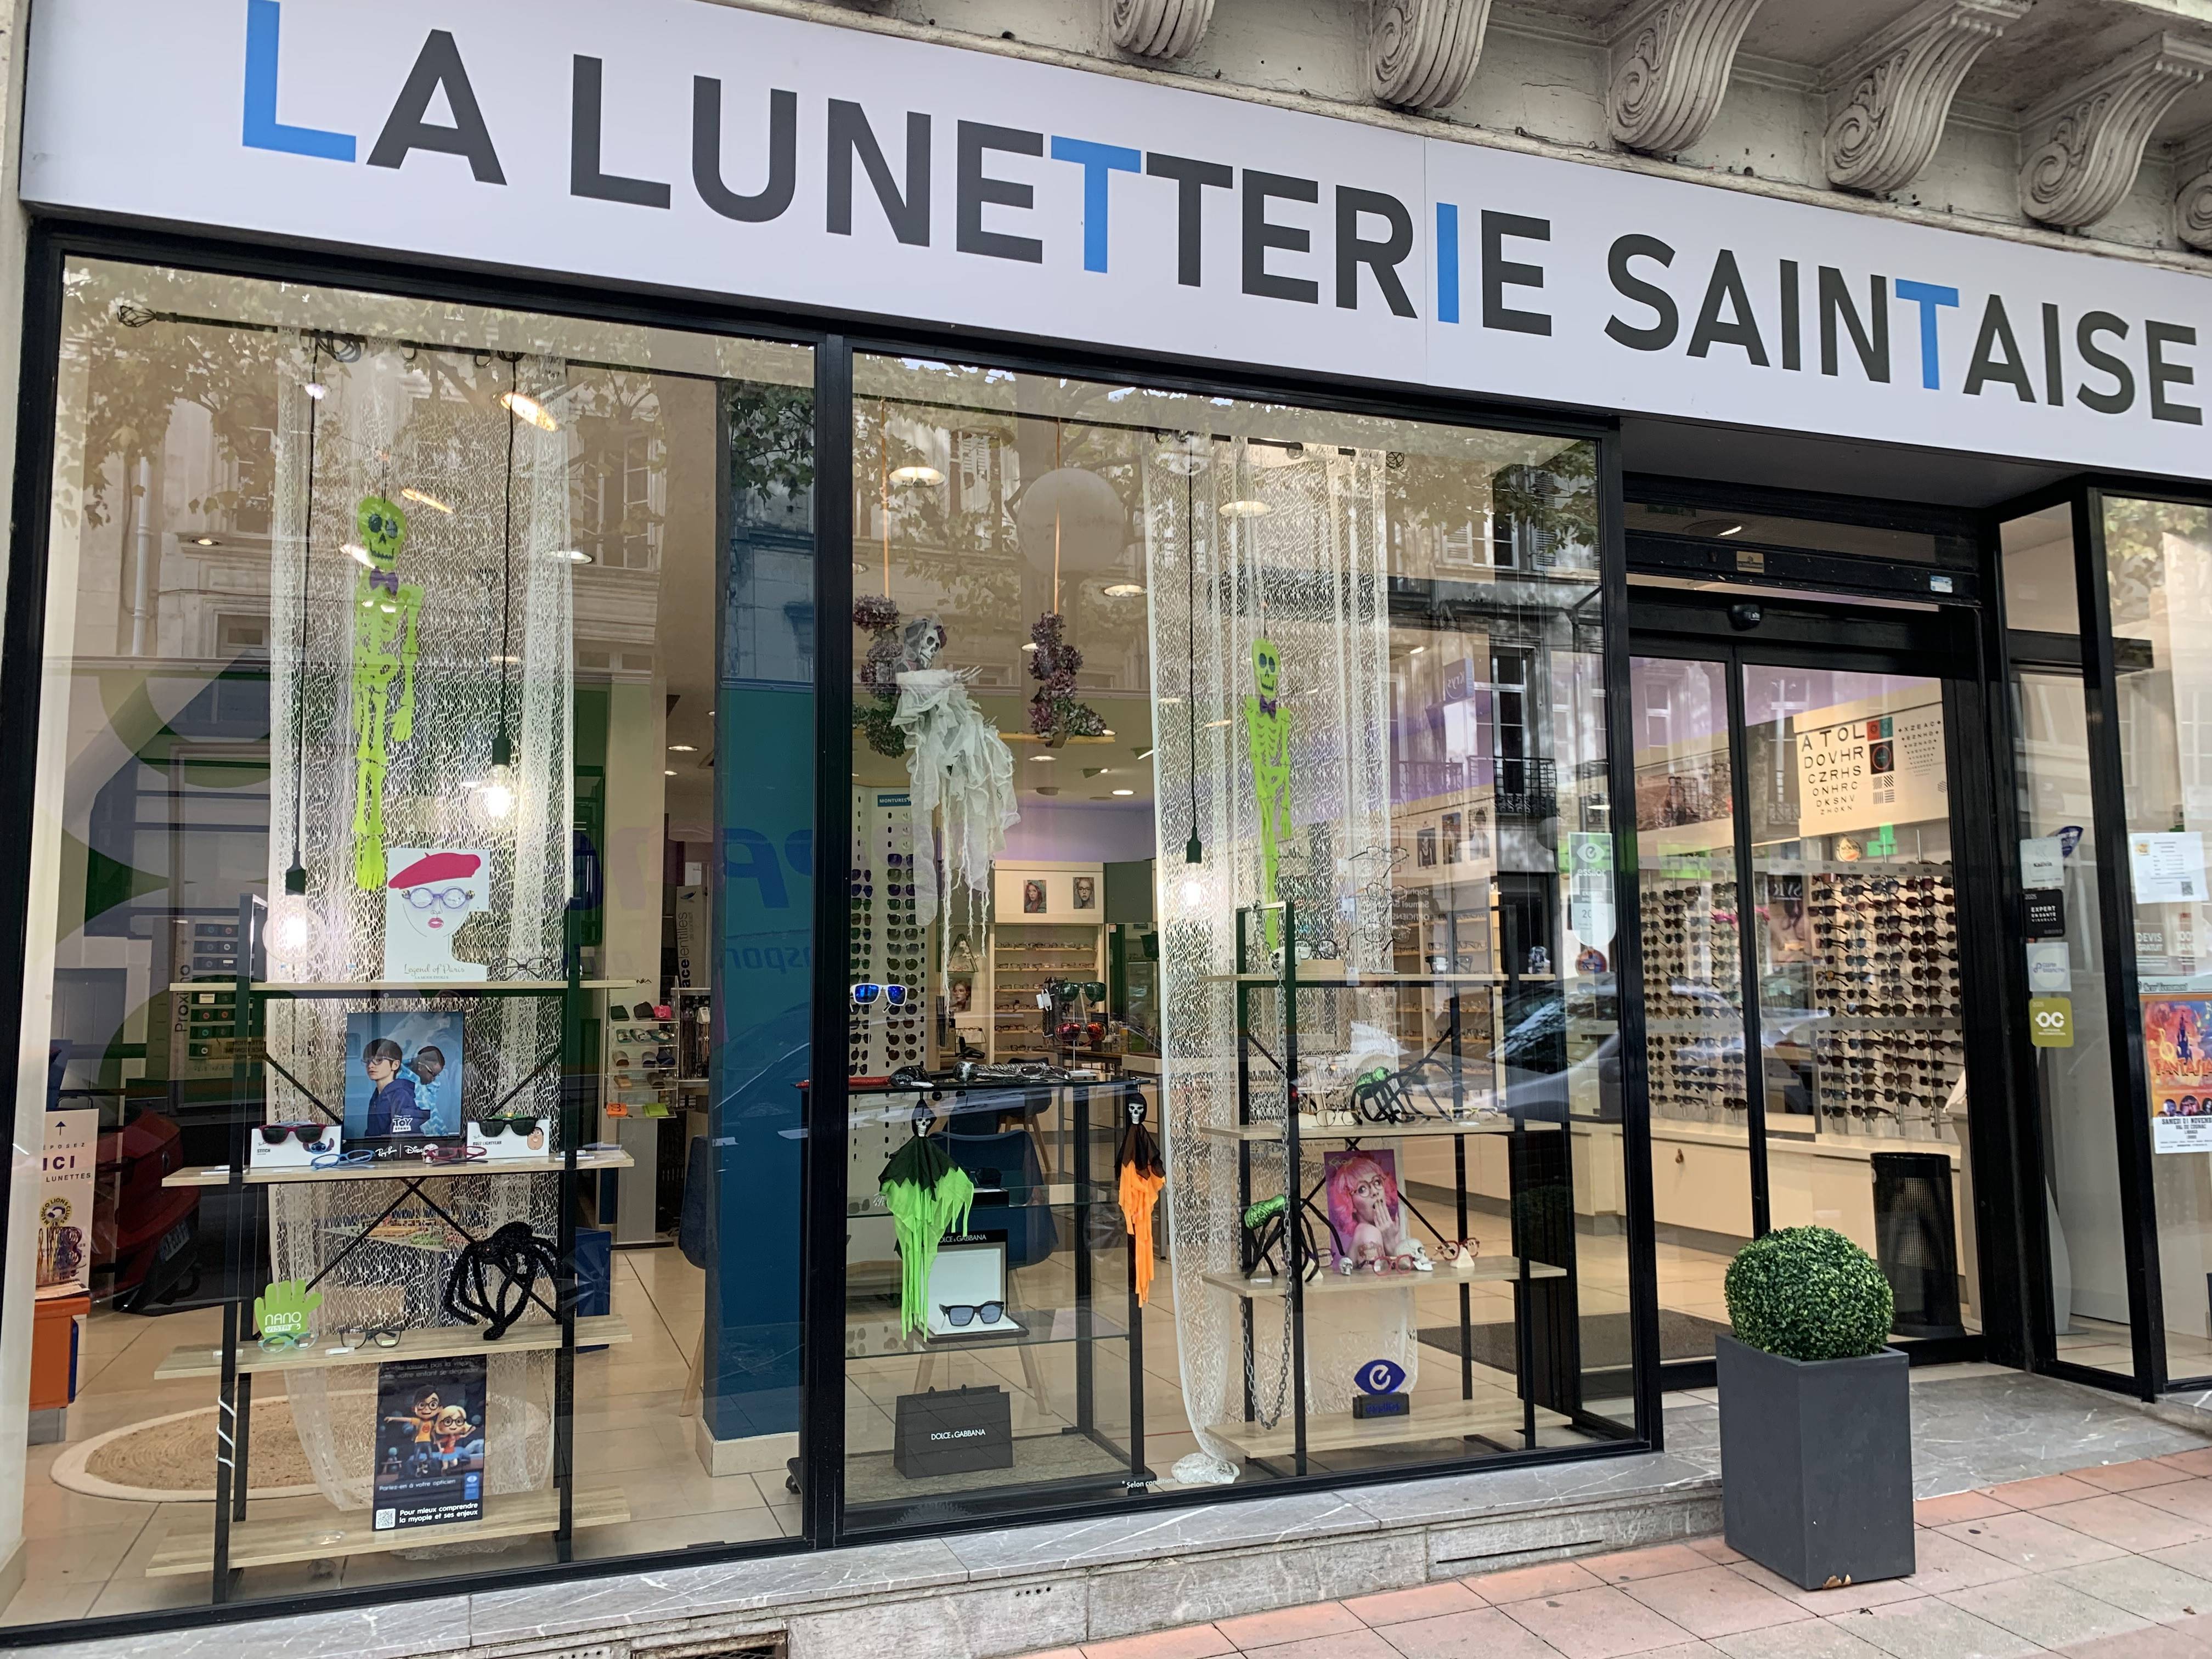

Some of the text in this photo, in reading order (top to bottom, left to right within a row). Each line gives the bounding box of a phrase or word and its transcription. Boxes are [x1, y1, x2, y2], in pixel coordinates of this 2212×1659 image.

[242, 0, 2203, 426] LA LUNETTERIE SAINTAISE
[2136, 933, 2163, 943] DEVIS
[404, 963, 465, 977] Legend of Paris
[392, 1118, 413, 1127] TOY
[42, 1155, 75, 1171] ICI
[46, 1173, 92, 1182] LUNETTES
[1126, 1480, 1144, 1489] Selon
[438, 1502, 478, 1513] comprendre
[408, 1514, 432, 1523] myopie
[456, 1509, 478, 1519] enjeux
